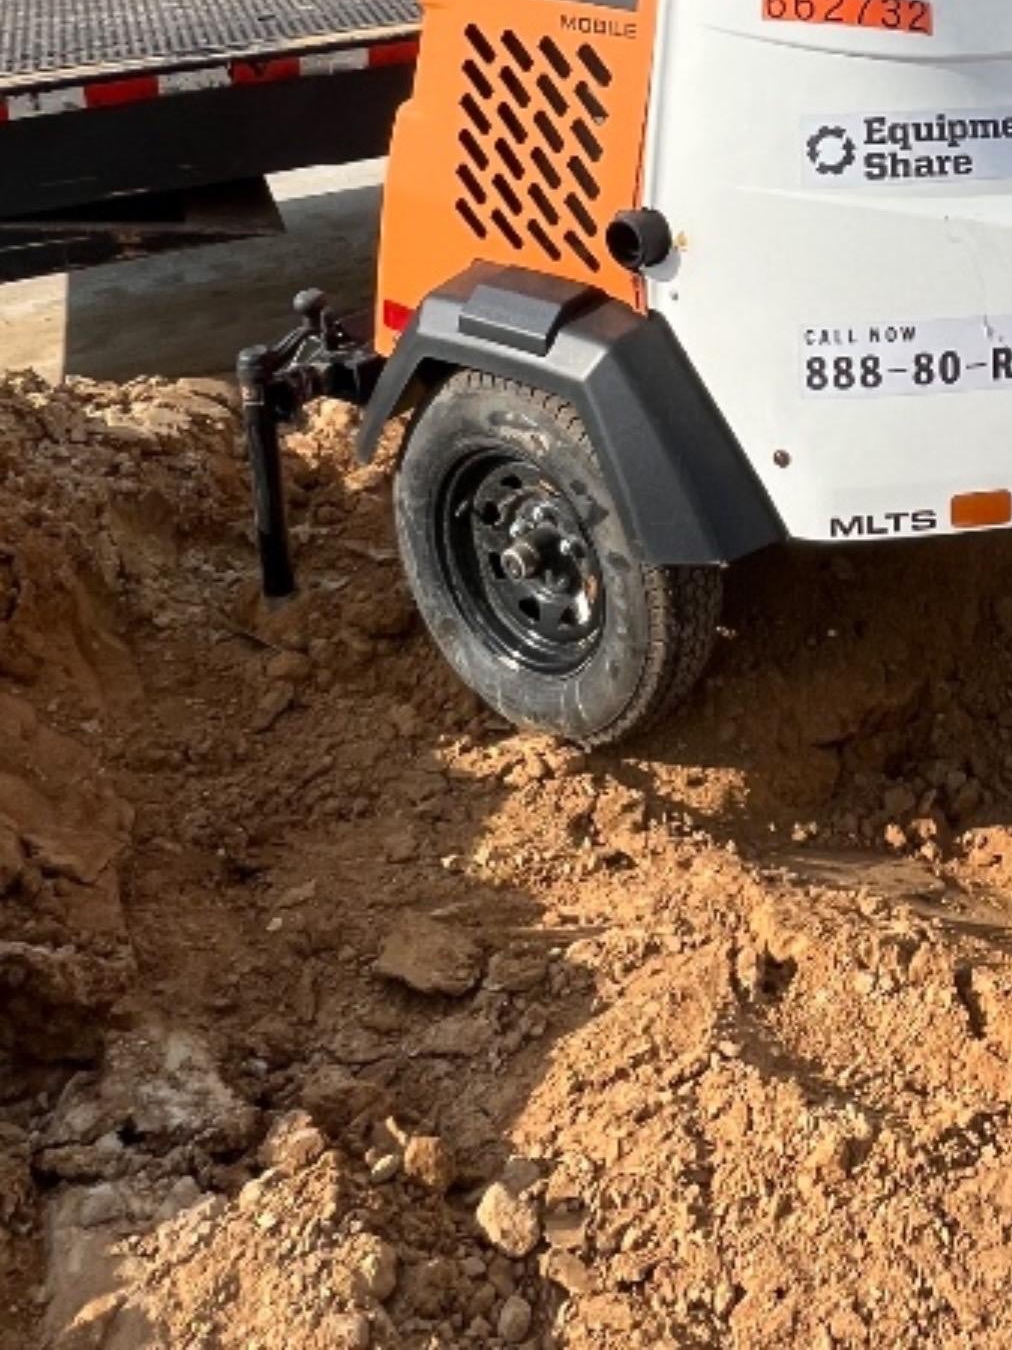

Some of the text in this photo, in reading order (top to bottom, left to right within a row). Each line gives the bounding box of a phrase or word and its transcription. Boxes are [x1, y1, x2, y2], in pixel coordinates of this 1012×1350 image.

[559, 14, 638, 39] MOBILE
[863, 151, 973, 181] Share
[803, 325, 917, 347] CALL NOW
[830, 509, 937, 538] MLTS
